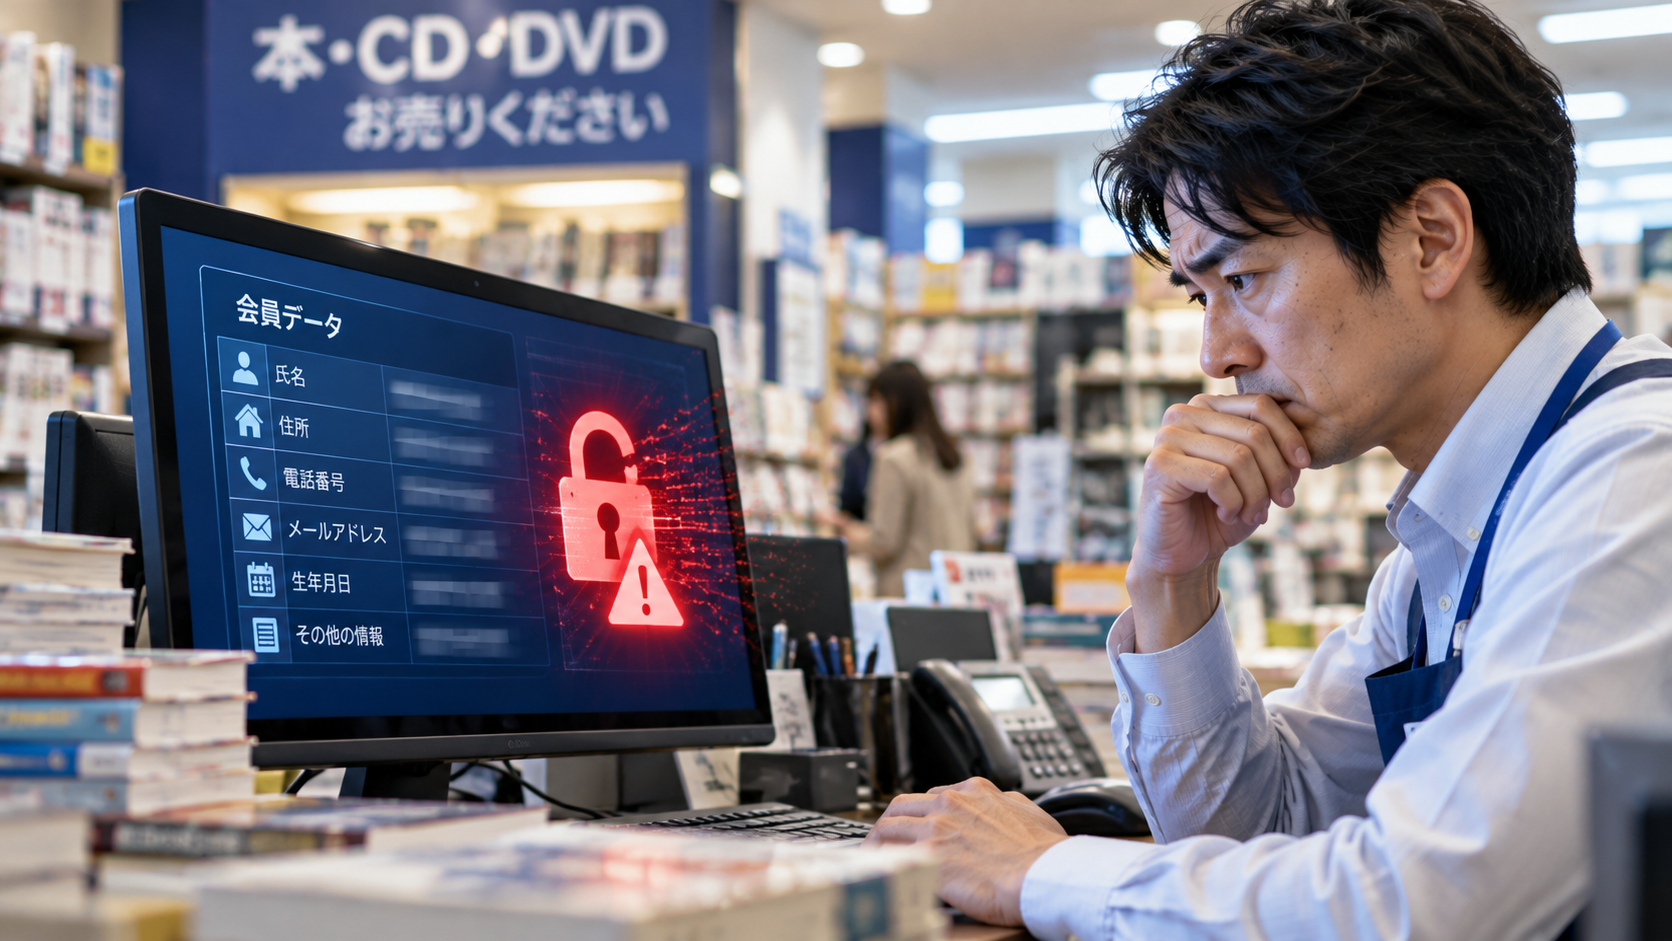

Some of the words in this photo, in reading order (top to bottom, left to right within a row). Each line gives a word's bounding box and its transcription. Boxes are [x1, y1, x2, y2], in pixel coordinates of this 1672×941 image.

[343, 87, 670, 152] お売りください
[236, 293, 342, 339] 会員データ
[275, 364, 306, 388] 氏名
[279, 415, 310, 439] 住所
[283, 467, 345, 493] 電話番号
[288, 520, 387, 544] メールアドレス
[291, 571, 351, 594] 生年月日
[295, 624, 385, 647] その他の情報
